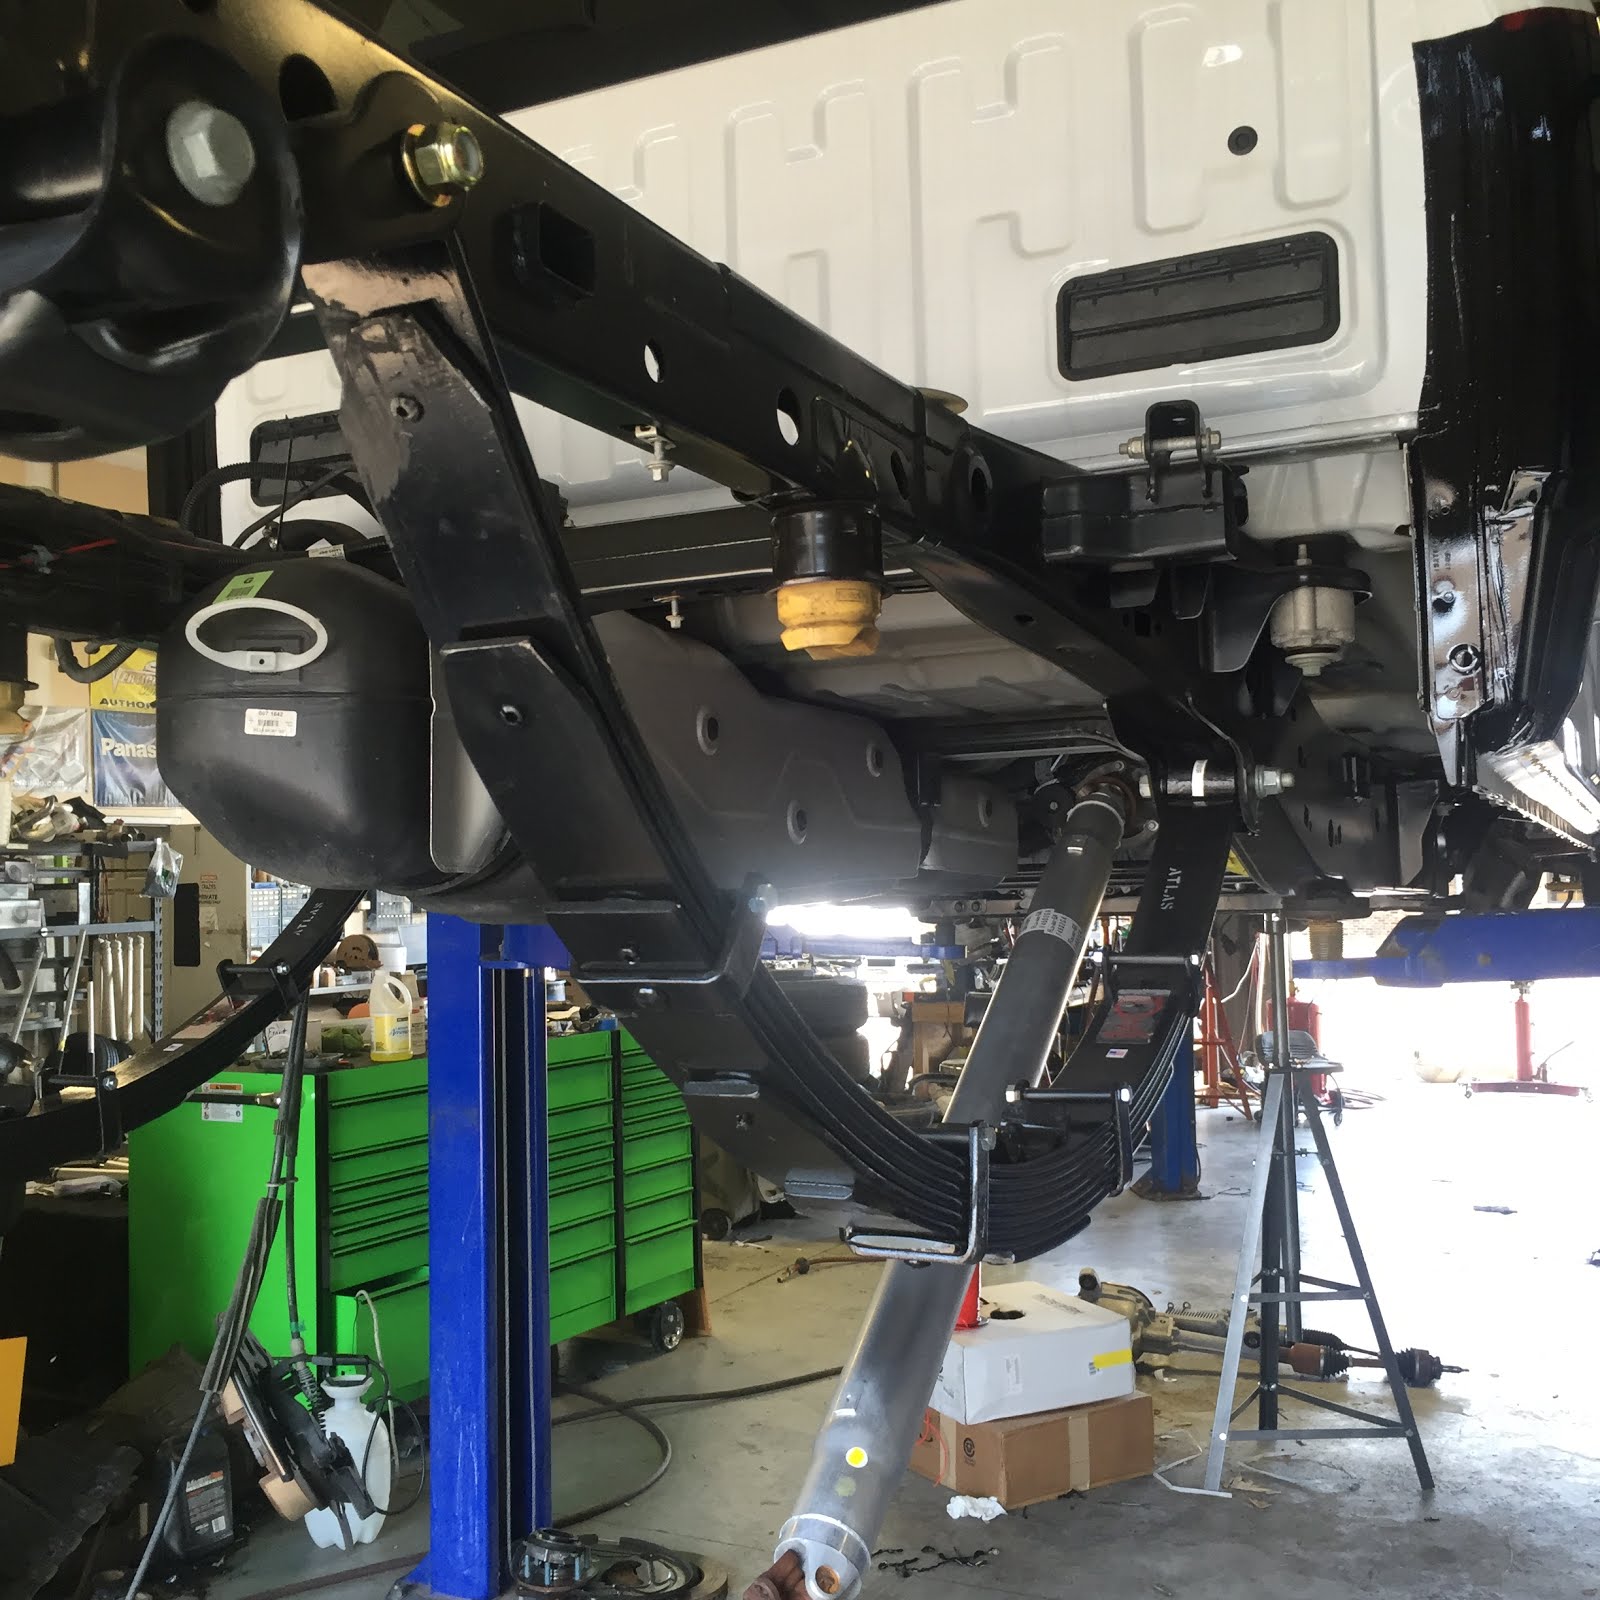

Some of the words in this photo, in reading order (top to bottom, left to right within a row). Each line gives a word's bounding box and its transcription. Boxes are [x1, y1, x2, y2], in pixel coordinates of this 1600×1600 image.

[101, 737, 157, 760] Panas
[1160, 867, 1182, 910] ATLAS
[294, 902, 323, 936] ATLAS
